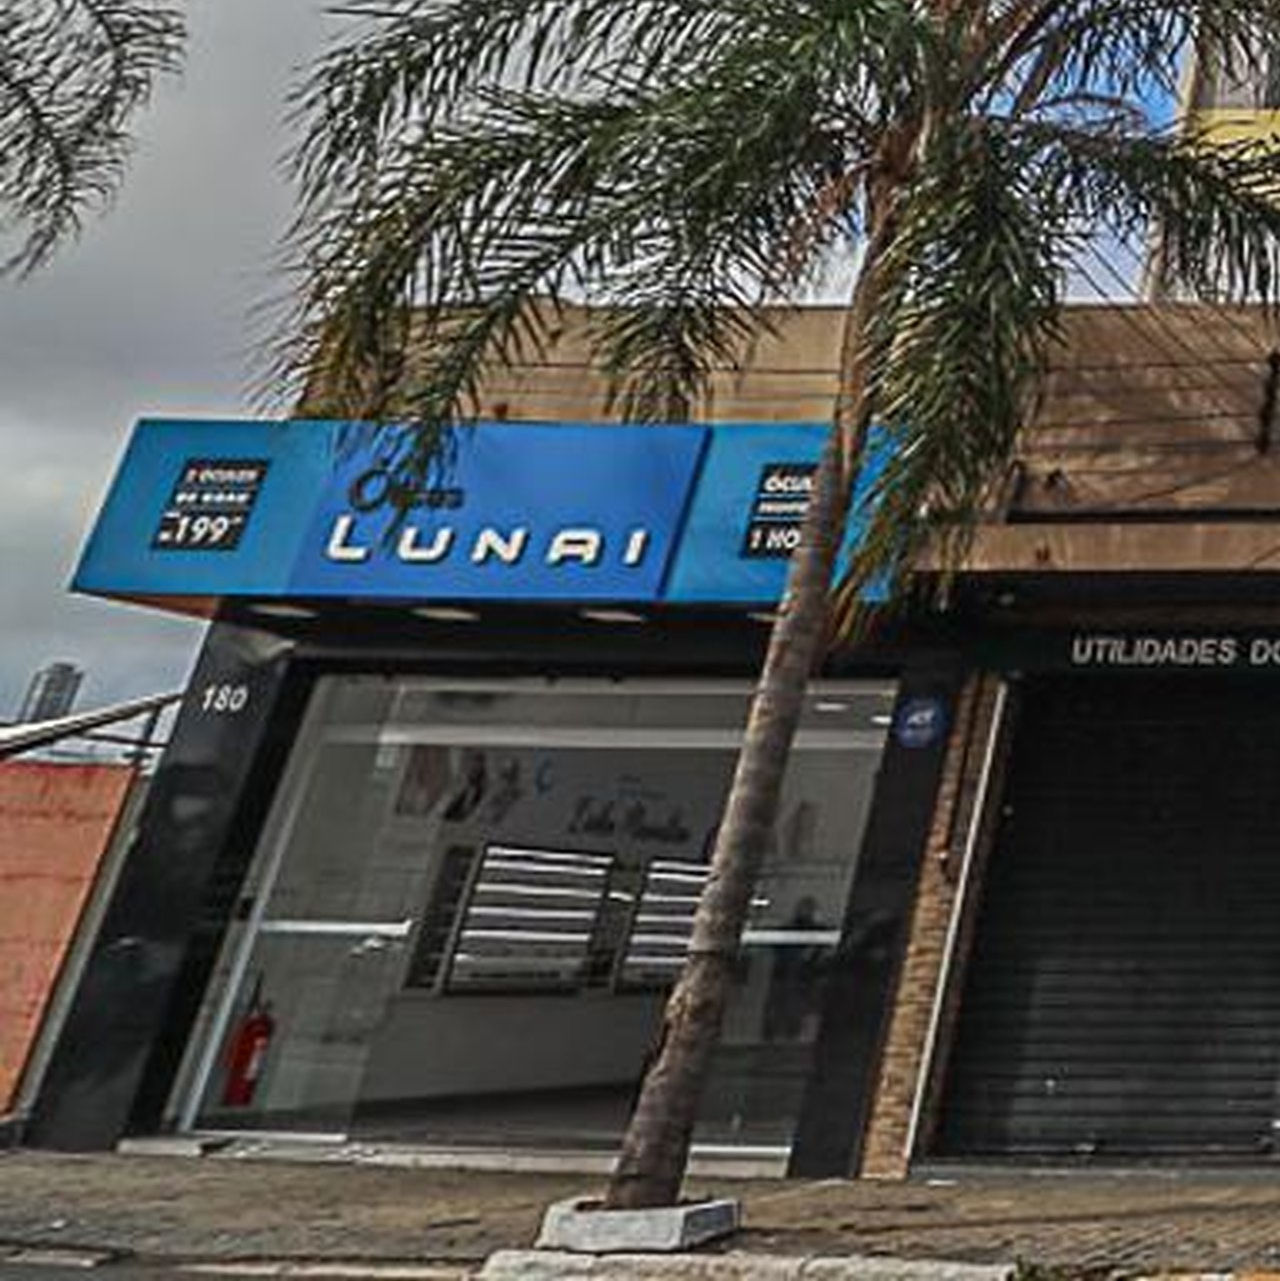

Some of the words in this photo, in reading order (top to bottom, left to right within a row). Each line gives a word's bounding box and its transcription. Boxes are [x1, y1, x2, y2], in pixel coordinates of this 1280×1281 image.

[325, 515, 649, 562] LUNAI
[1072, 635, 1237, 665] UTILIDADES
[202, 684, 249, 712] 180
